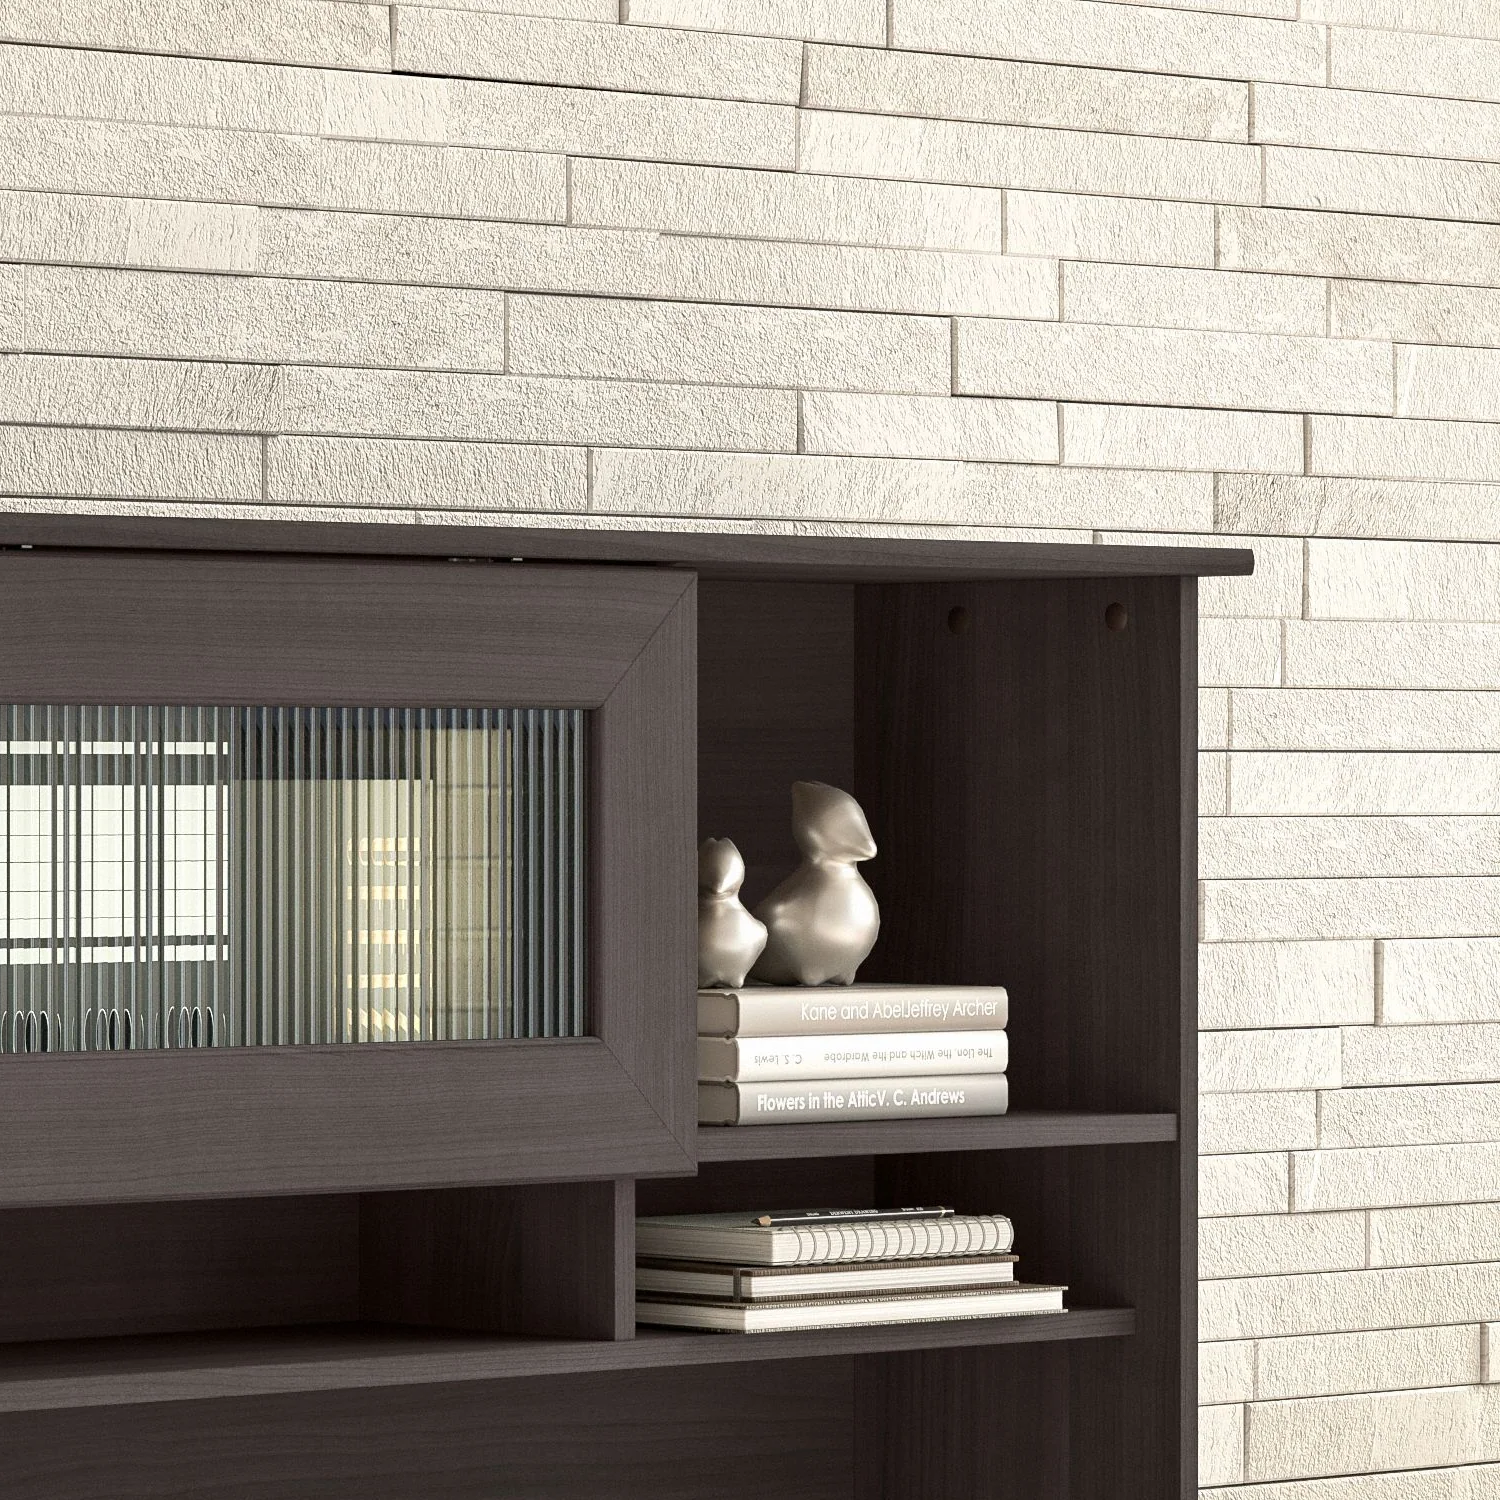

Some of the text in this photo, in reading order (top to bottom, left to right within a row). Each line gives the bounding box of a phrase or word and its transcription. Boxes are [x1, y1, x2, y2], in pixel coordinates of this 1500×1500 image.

[801, 1002, 837, 1020] Kane
[841, 1001, 869, 1020] and
[953, 999, 998, 1016] Archer
[824, 1052, 869, 1063] Wardrobe
[872, 1051, 887, 1062] the
[889, 1051, 907, 1062] and
[909, 1049, 935, 1061] Witch
[937, 1048, 952, 1060] the
[978, 1047, 993, 1058] The
[754, 1055, 779, 1066] Lewis
[757, 1094, 805, 1112] Flowers
[808, 1092, 820, 1109] in
[823, 1091, 844, 1108] the
[893, 1089, 907, 1105] C.
[910, 1088, 965, 1105] Andrews
